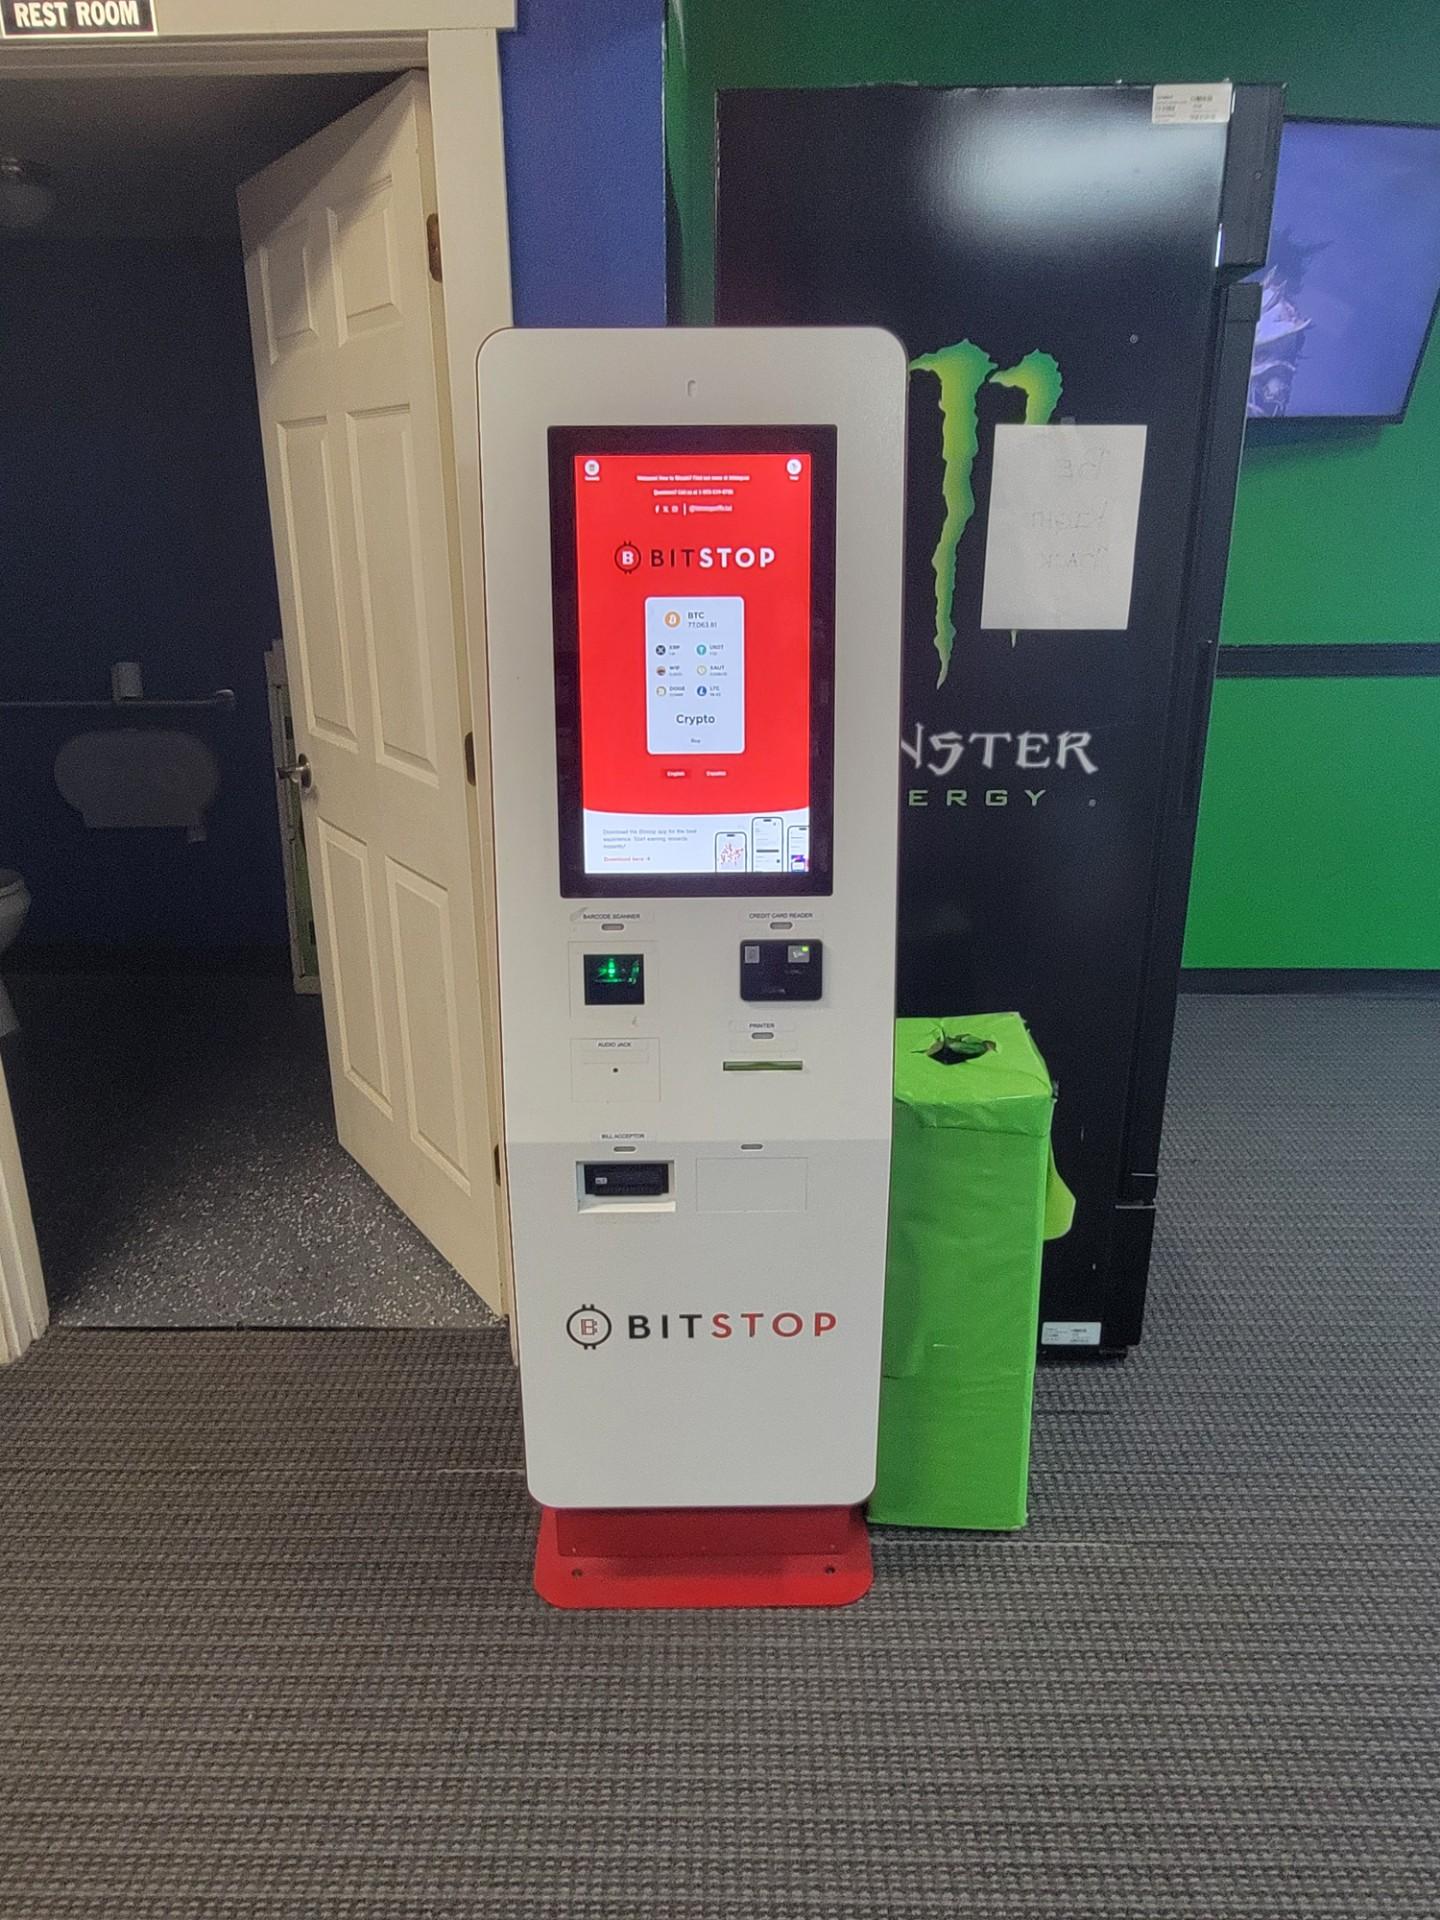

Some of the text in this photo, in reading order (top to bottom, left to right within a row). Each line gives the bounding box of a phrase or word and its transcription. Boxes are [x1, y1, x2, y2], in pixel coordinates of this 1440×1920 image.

[13, 0, 141, 28] REST ROOM
[651, 547, 776, 569] BITSTOP
[687, 611, 705, 620] BTC
[675, 713, 716, 726] Crypto
[900, 722, 1099, 777] NSTER
[908, 789, 1047, 807] ERGY
[583, 912, 641, 920] BARCODE SCANNER
[628, 1311, 837, 1340] BITSTOP
